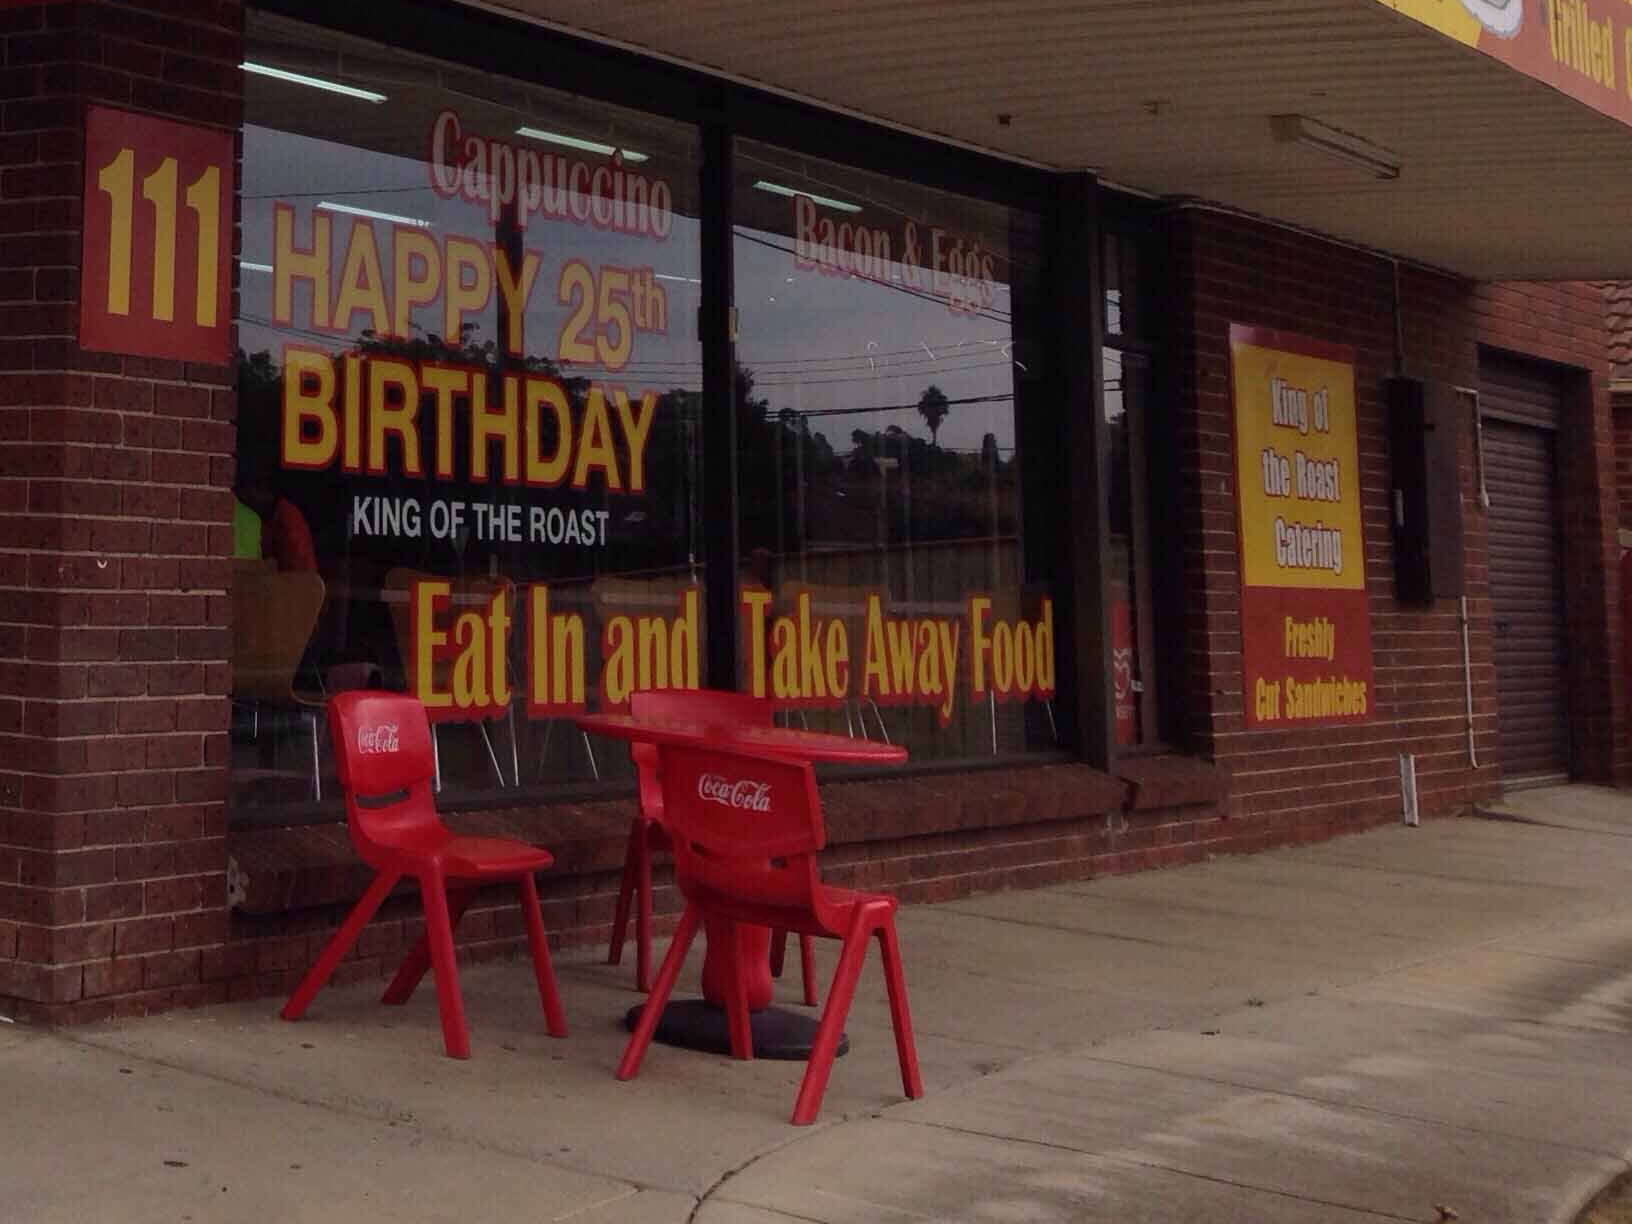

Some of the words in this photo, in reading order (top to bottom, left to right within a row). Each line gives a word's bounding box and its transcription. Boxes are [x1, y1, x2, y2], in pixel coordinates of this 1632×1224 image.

[430, 109, 672, 239] Cappuccino
[99, 147, 220, 329] 111
[792, 192, 896, 284] Bacon
[272, 204, 541, 358] HAPPY
[557, 259, 667, 370] 25th
[281, 346, 658, 492] BIRTHDAY
[1272, 378, 1308, 436] King
[1313, 384, 1330, 433] of
[1263, 447, 1291, 499] the
[1295, 449, 1341, 502] Roast
[352, 495, 422, 538] KING
[429, 499, 466, 539] OF
[472, 502, 523, 543] THE
[529, 507, 610, 546] ROAST
[1274, 515, 1344, 575] Catering
[413, 577, 513, 714] Eat
[528, 581, 587, 710] In
[604, 587, 700, 708] and
[740, 589, 849, 702] Take
[863, 593, 960, 721] Away
[970, 595, 1056, 696] Food
[1285, 616, 1335, 662] Freshly
[1255, 677, 1280, 722] Cut
[1285, 676, 1367, 720] Sandwiches
[697, 773, 772, 813] Coca-Cola
